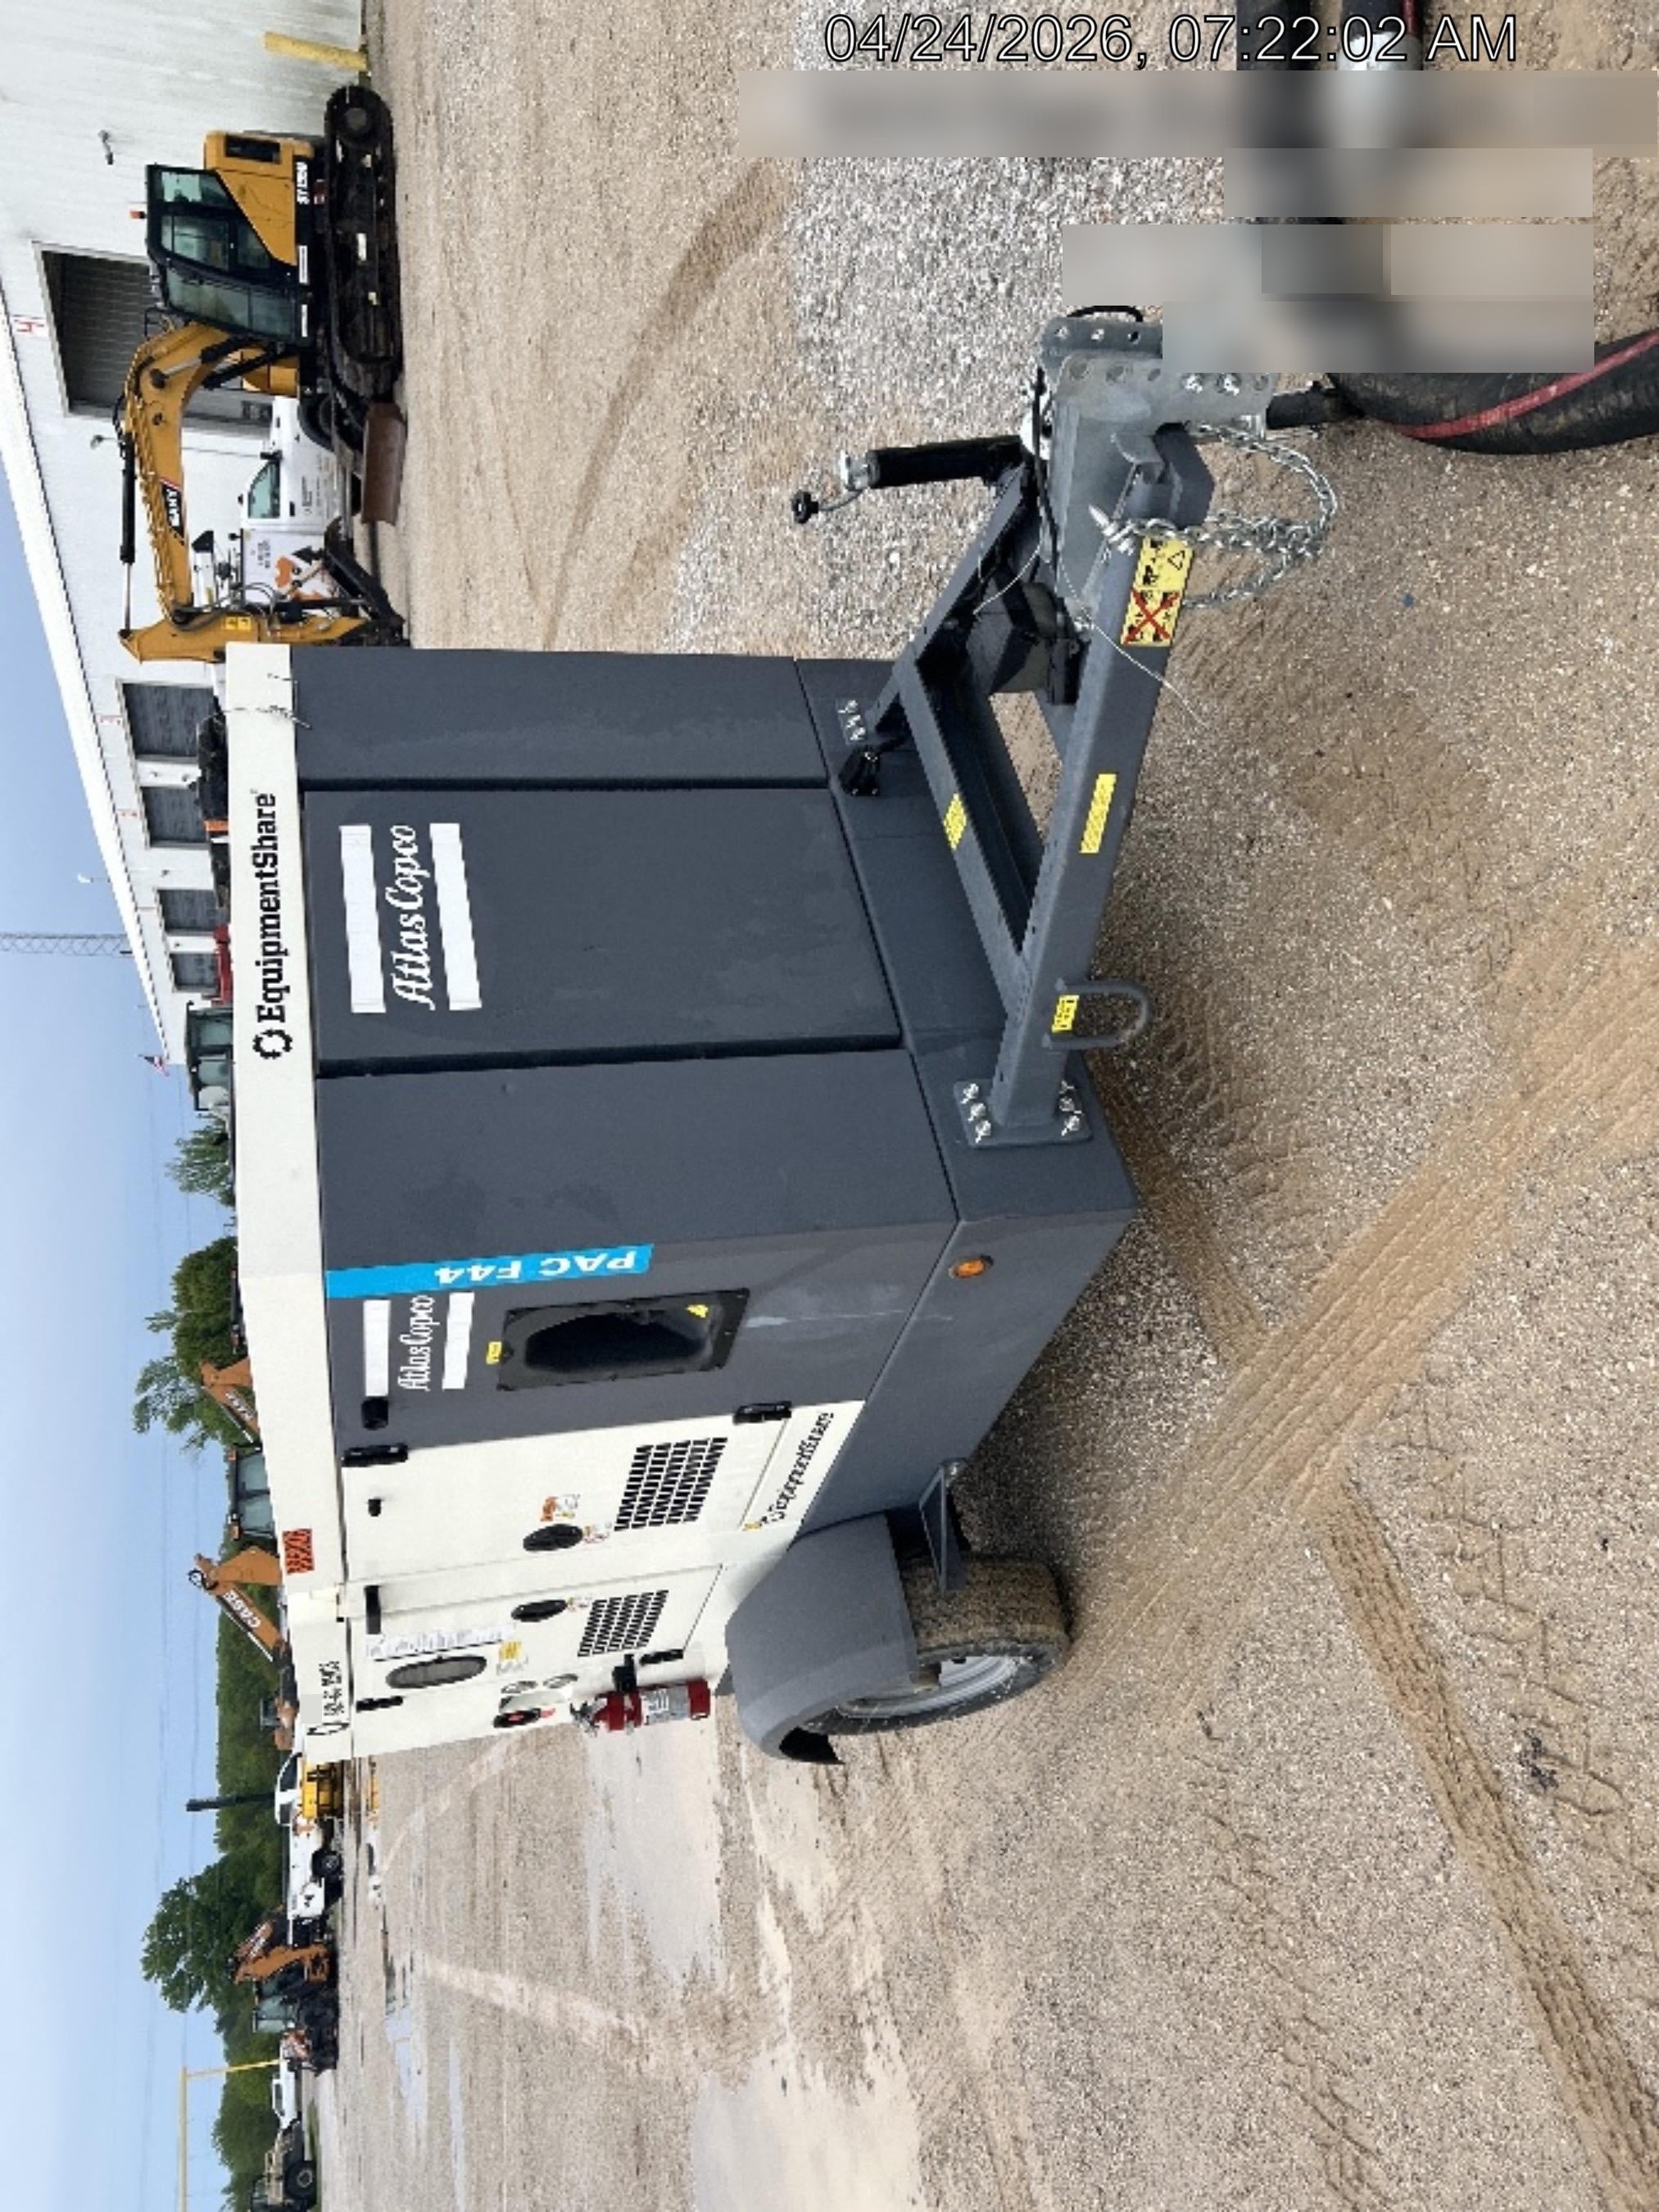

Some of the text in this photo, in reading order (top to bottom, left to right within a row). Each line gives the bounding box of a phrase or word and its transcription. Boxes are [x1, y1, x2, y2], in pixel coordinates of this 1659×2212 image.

[250, 792, 290, 1023] EquipmentShare
[384, 824, 436, 1011] Atlas Copco
[433, 1250, 637, 1285] PAC F44
[397, 1294, 441, 1391] Atlas Copco
